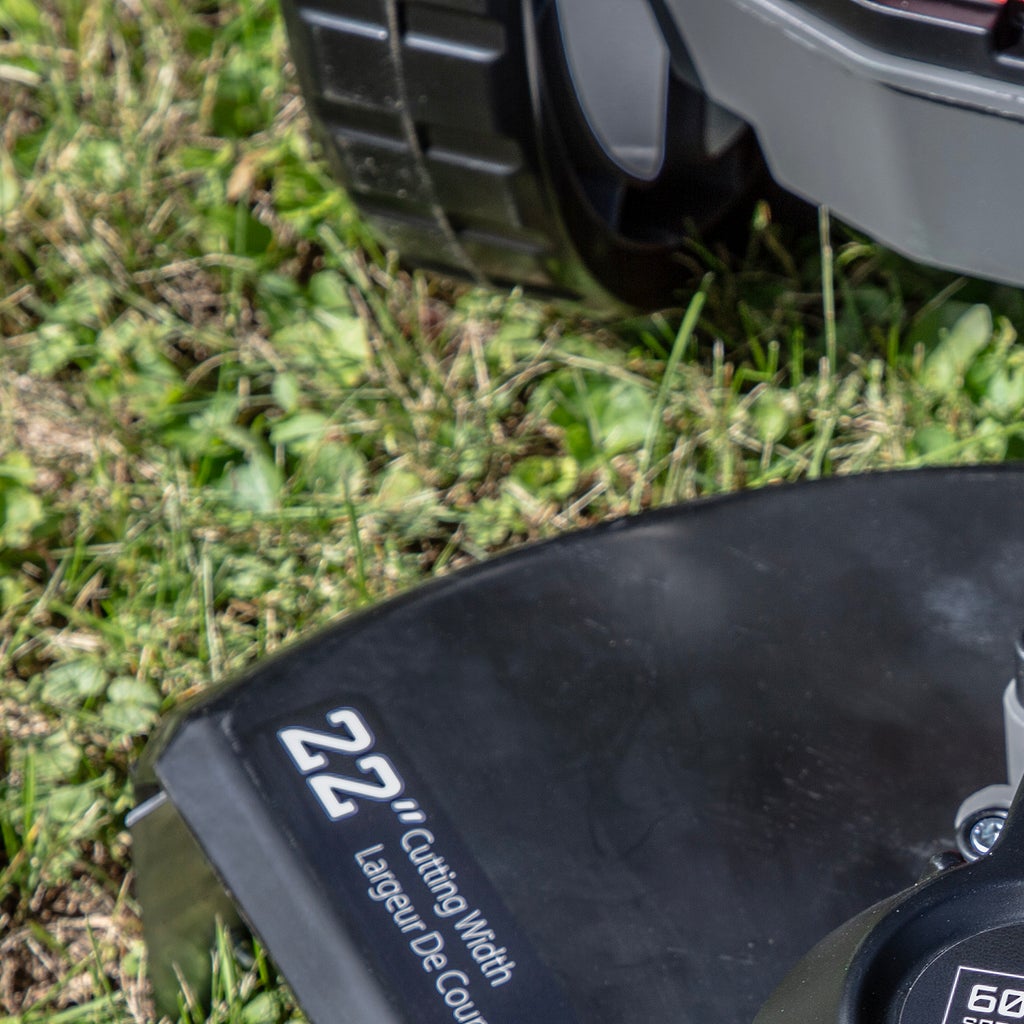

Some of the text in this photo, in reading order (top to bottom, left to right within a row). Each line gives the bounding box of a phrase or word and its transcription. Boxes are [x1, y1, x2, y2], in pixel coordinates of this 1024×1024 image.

[354, 843, 427, 933] Largeur
[410, 930, 447, 973] De
[401, 828, 468, 918] Cutting
[454, 909, 516, 987] Width
